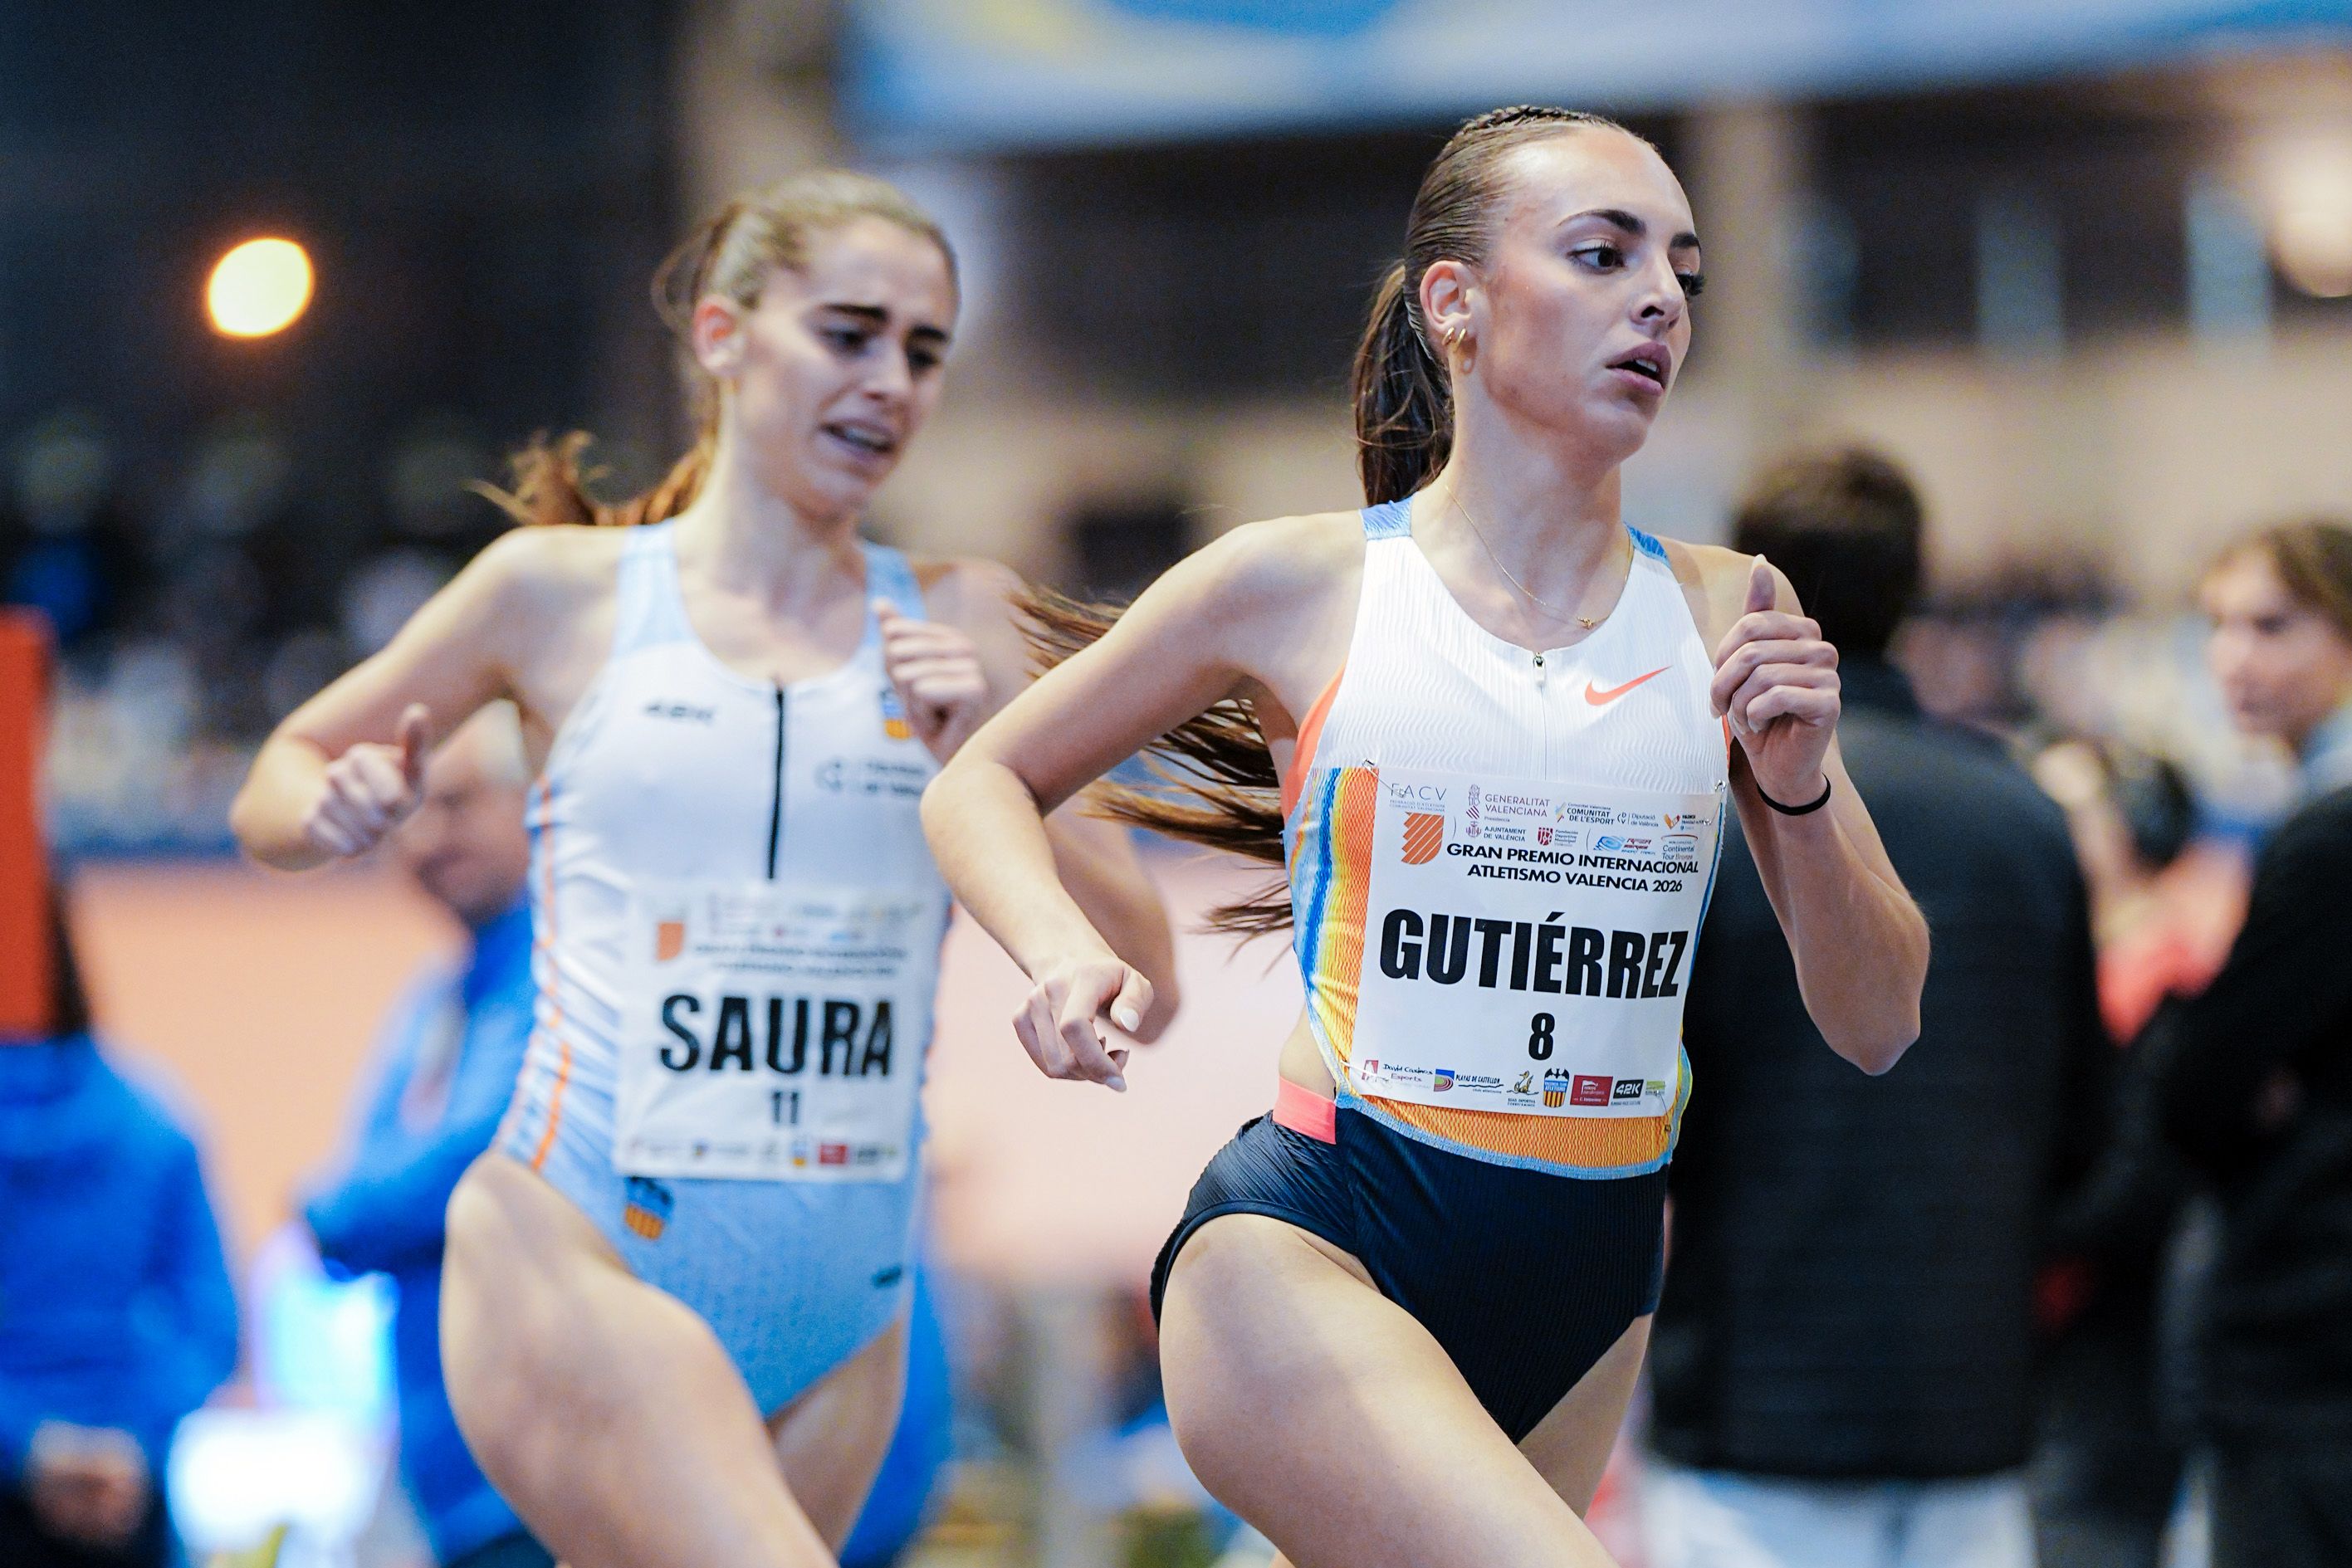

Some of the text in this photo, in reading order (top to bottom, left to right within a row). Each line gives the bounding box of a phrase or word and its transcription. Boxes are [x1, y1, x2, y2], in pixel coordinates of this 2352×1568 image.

[1391, 783, 1447, 801] FACV
[1484, 794, 1550, 807] GENERALITAT
[1485, 804, 1548, 818] VALENCIANA
[1567, 808, 1611, 818] COMUNITAT
[1580, 815, 1615, 826] L'ESPORT
[1484, 826, 1526, 835] AJUNTAMENT
[1663, 844, 1695, 852] Continental
[1447, 843, 1699, 874] GRAN PREMIO INTERNACIONAL
[1467, 864, 1682, 892] ATLETISMO VALENCIA 2026
[1380, 909, 1689, 999] GUTIÉRREZ
[661, 995, 891, 1076] SAURA
[1528, 1013, 1555, 1060] 8
[1383, 1063, 1402, 1072] David
[1391, 1073, 1422, 1082] Esports
[1616, 1083, 1641, 1095] 42K
[773, 1091, 800, 1124] 11
